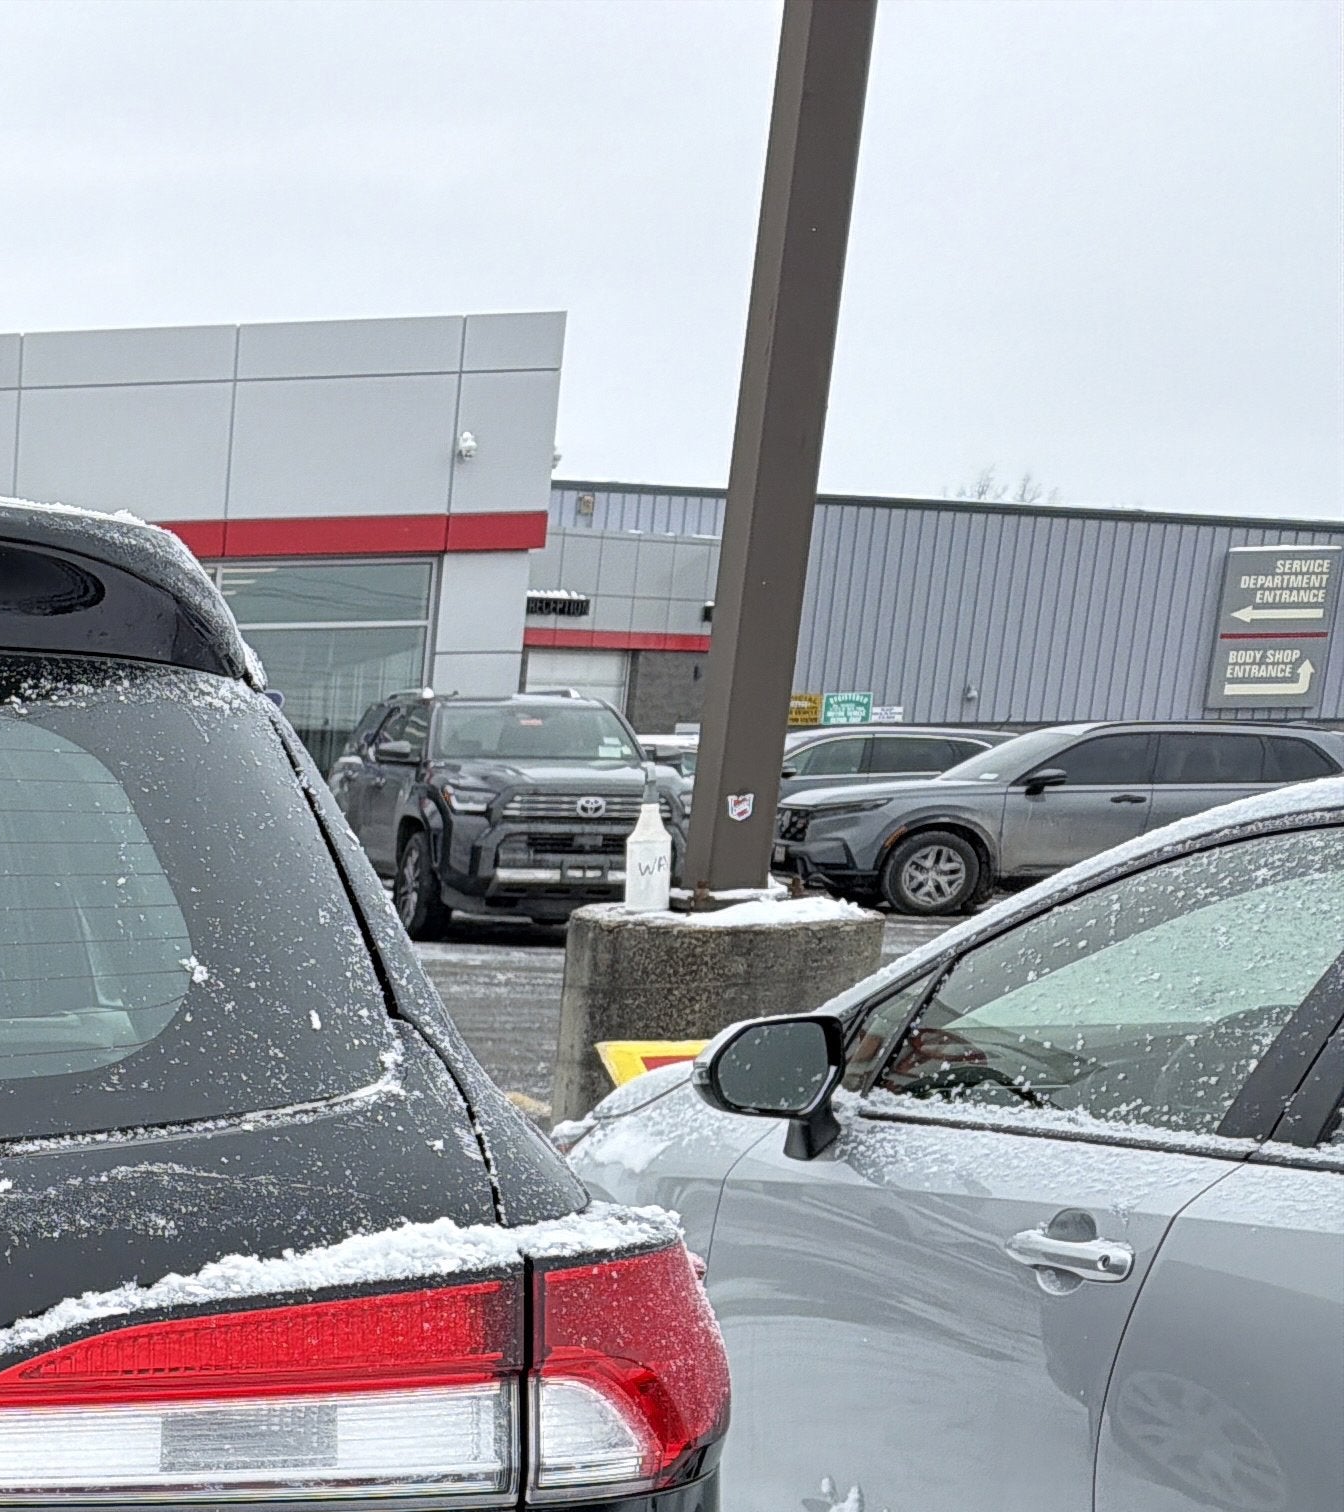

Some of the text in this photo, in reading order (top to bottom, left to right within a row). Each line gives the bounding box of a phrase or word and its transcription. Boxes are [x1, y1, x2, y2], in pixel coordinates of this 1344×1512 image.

[1275, 559, 1331, 573] SERVICE
[1240, 575, 1329, 589] DEPARTMENT
[1255, 589, 1326, 604] ENTRANCE
[1228, 649, 1301, 664] BODY SHOP
[1226, 664, 1293, 679] ENTRANCE
